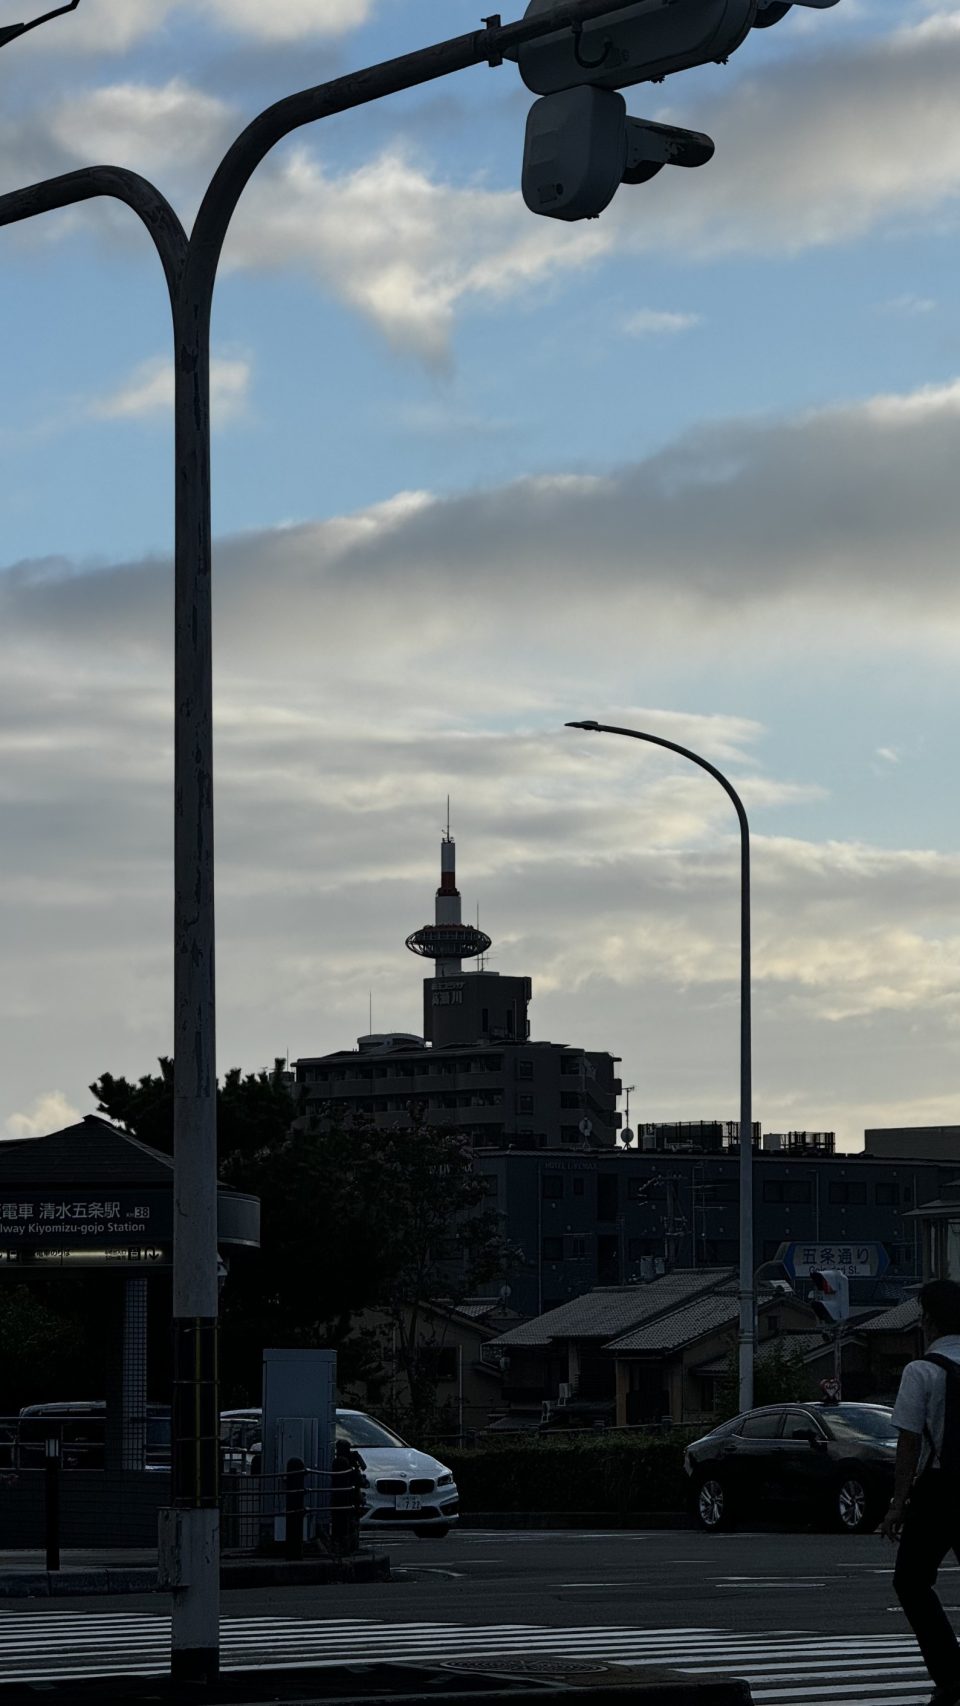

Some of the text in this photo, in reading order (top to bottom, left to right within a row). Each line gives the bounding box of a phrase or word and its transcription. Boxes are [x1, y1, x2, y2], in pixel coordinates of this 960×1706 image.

[0, 1201, 121, 1220] 電車 清水五条駅
[136, 1207, 149, 1218] 38
[28, 1223, 105, 1235] Kiyomizu-gojo
[107, 1222, 146, 1233] Station
[803, 1248, 869, 1264] 五条通り
